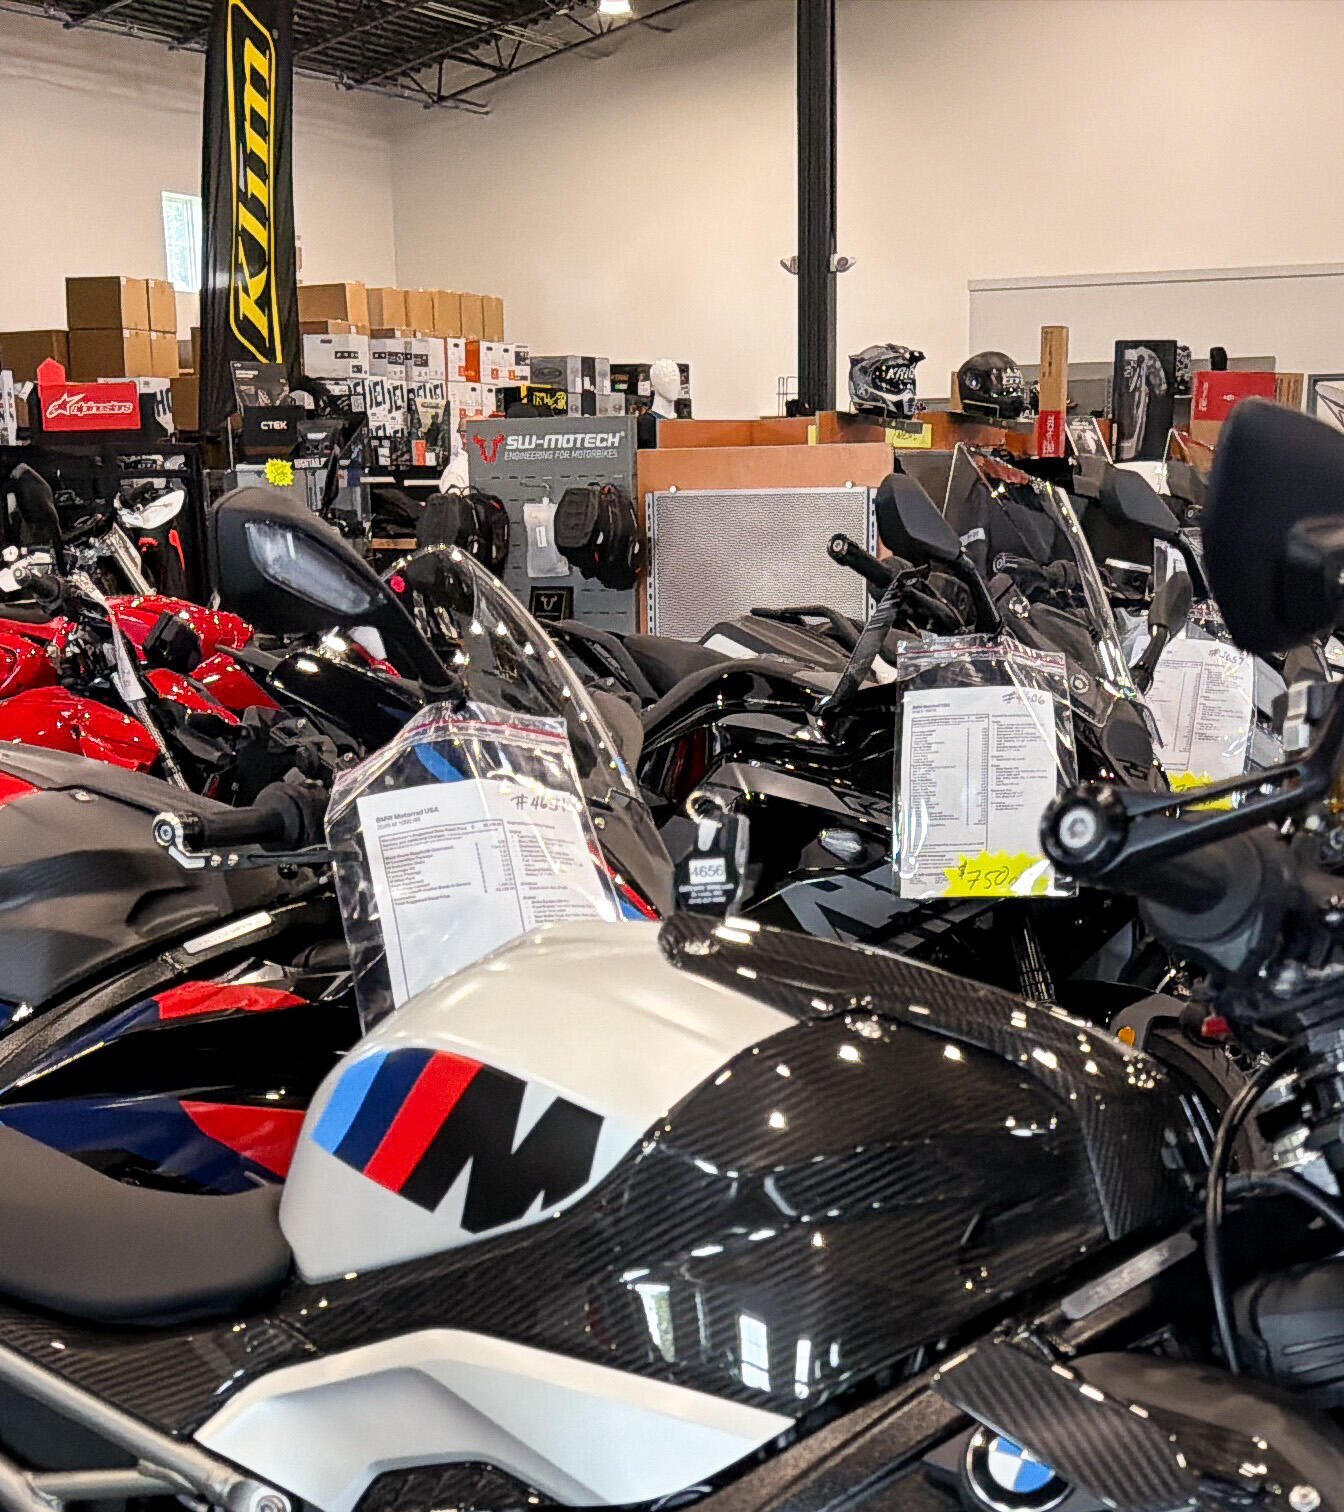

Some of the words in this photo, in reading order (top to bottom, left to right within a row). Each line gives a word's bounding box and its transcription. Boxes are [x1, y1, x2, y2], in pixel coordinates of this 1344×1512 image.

[260, 421, 288, 430] CTEK
[506, 433, 621, 450] SW-MOTECH
[505, 450, 554, 461] ENGINEERING
[555, 450, 571, 459] FOR
[571, 449, 618, 460] MOTORBIKES
[396, 1062, 606, 1235] M
